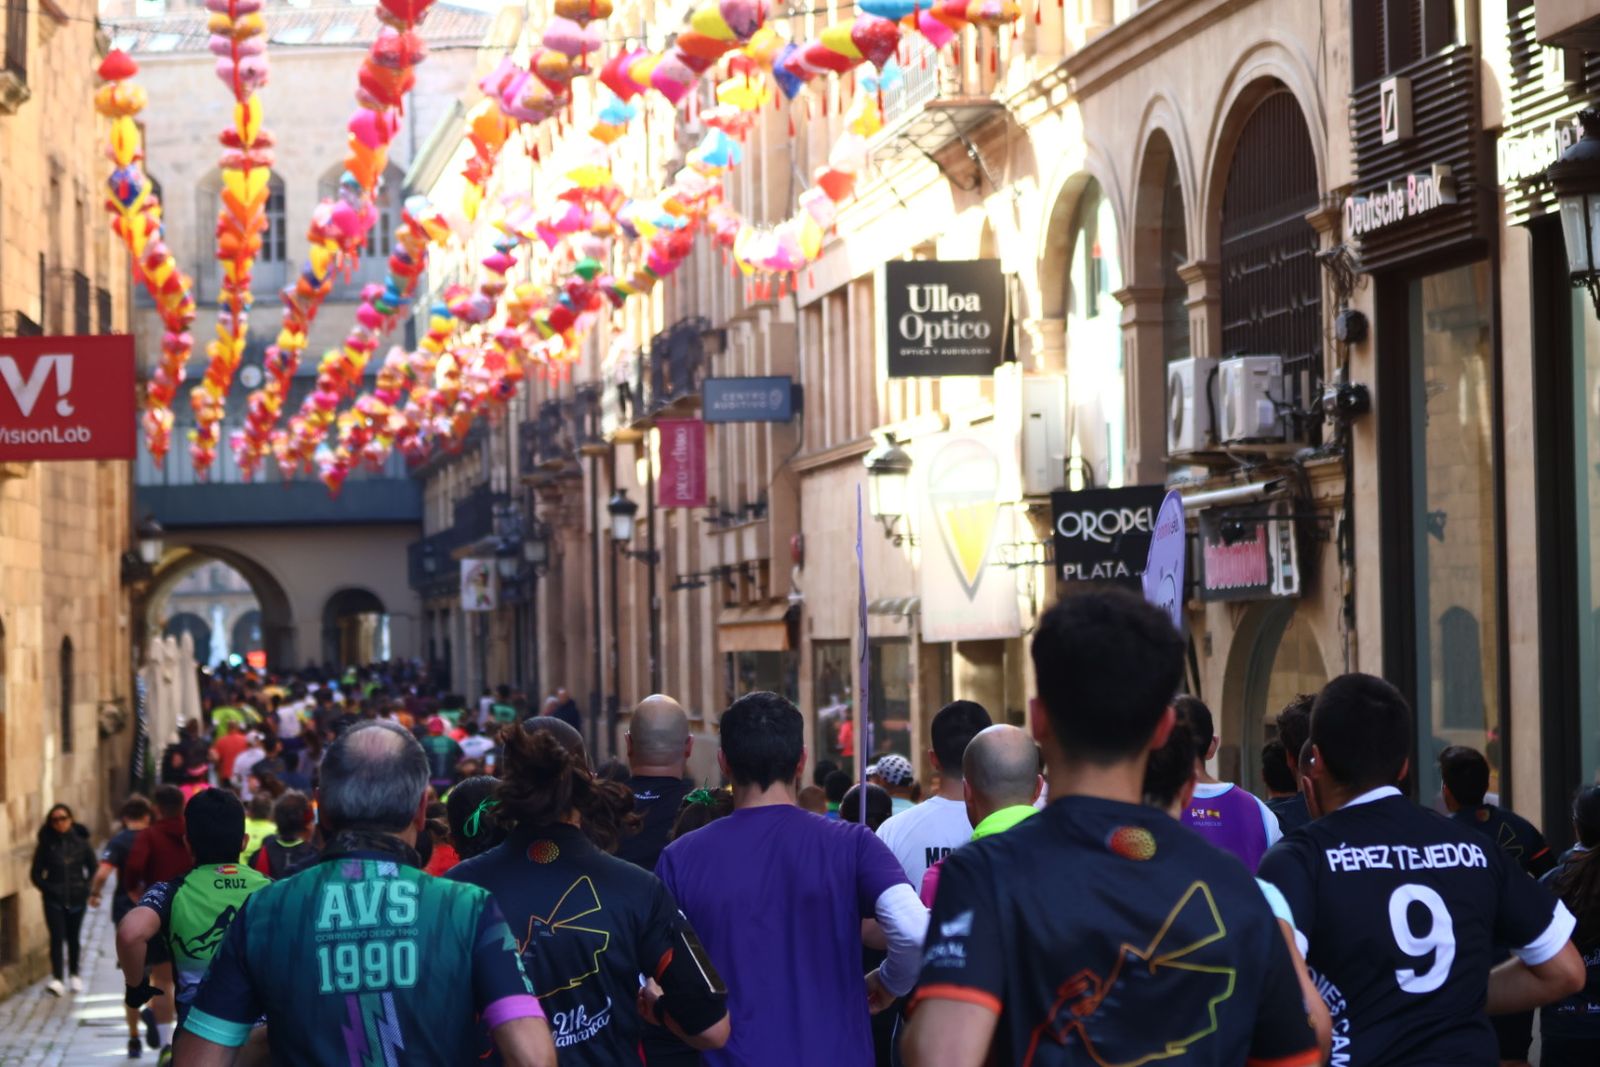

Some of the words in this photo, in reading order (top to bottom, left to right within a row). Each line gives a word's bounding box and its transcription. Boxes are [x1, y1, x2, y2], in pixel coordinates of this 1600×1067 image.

[1345, 181, 1405, 238] Deutsche
[1407, 163, 1443, 216] Bank
[906, 283, 982, 313] Ulloa
[899, 313, 991, 348] Optico
[1057, 506, 1155, 542] OROPEL
[1062, 562, 1130, 581] PLATA
[1325, 842, 1393, 872] PÉREZ
[1392, 843, 1488, 870] TEJEDOR
[213, 878, 248, 889] CRUZ
[317, 880, 418, 930] AVS
[1388, 883, 1456, 993] 9
[318, 941, 418, 993] 1990
